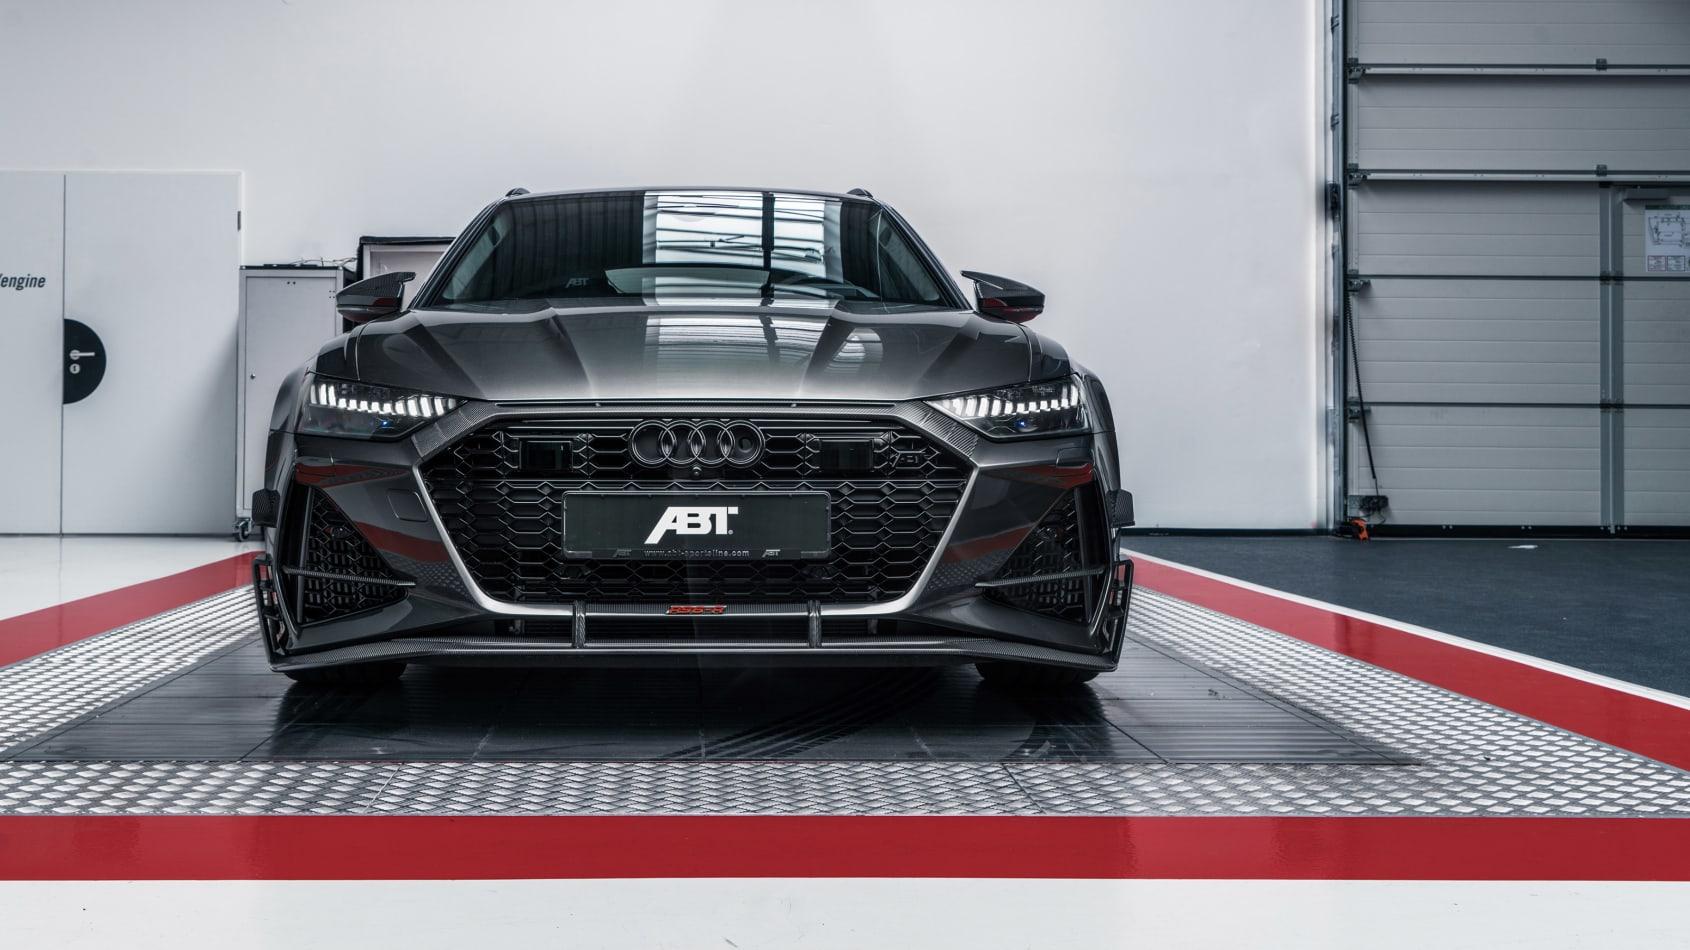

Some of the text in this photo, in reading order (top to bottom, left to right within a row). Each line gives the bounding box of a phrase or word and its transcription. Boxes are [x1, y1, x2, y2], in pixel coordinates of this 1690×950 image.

[565, 277, 590, 289] ABT
[644, 506, 739, 545] ABT
[761, 549, 781, 558] ABT
